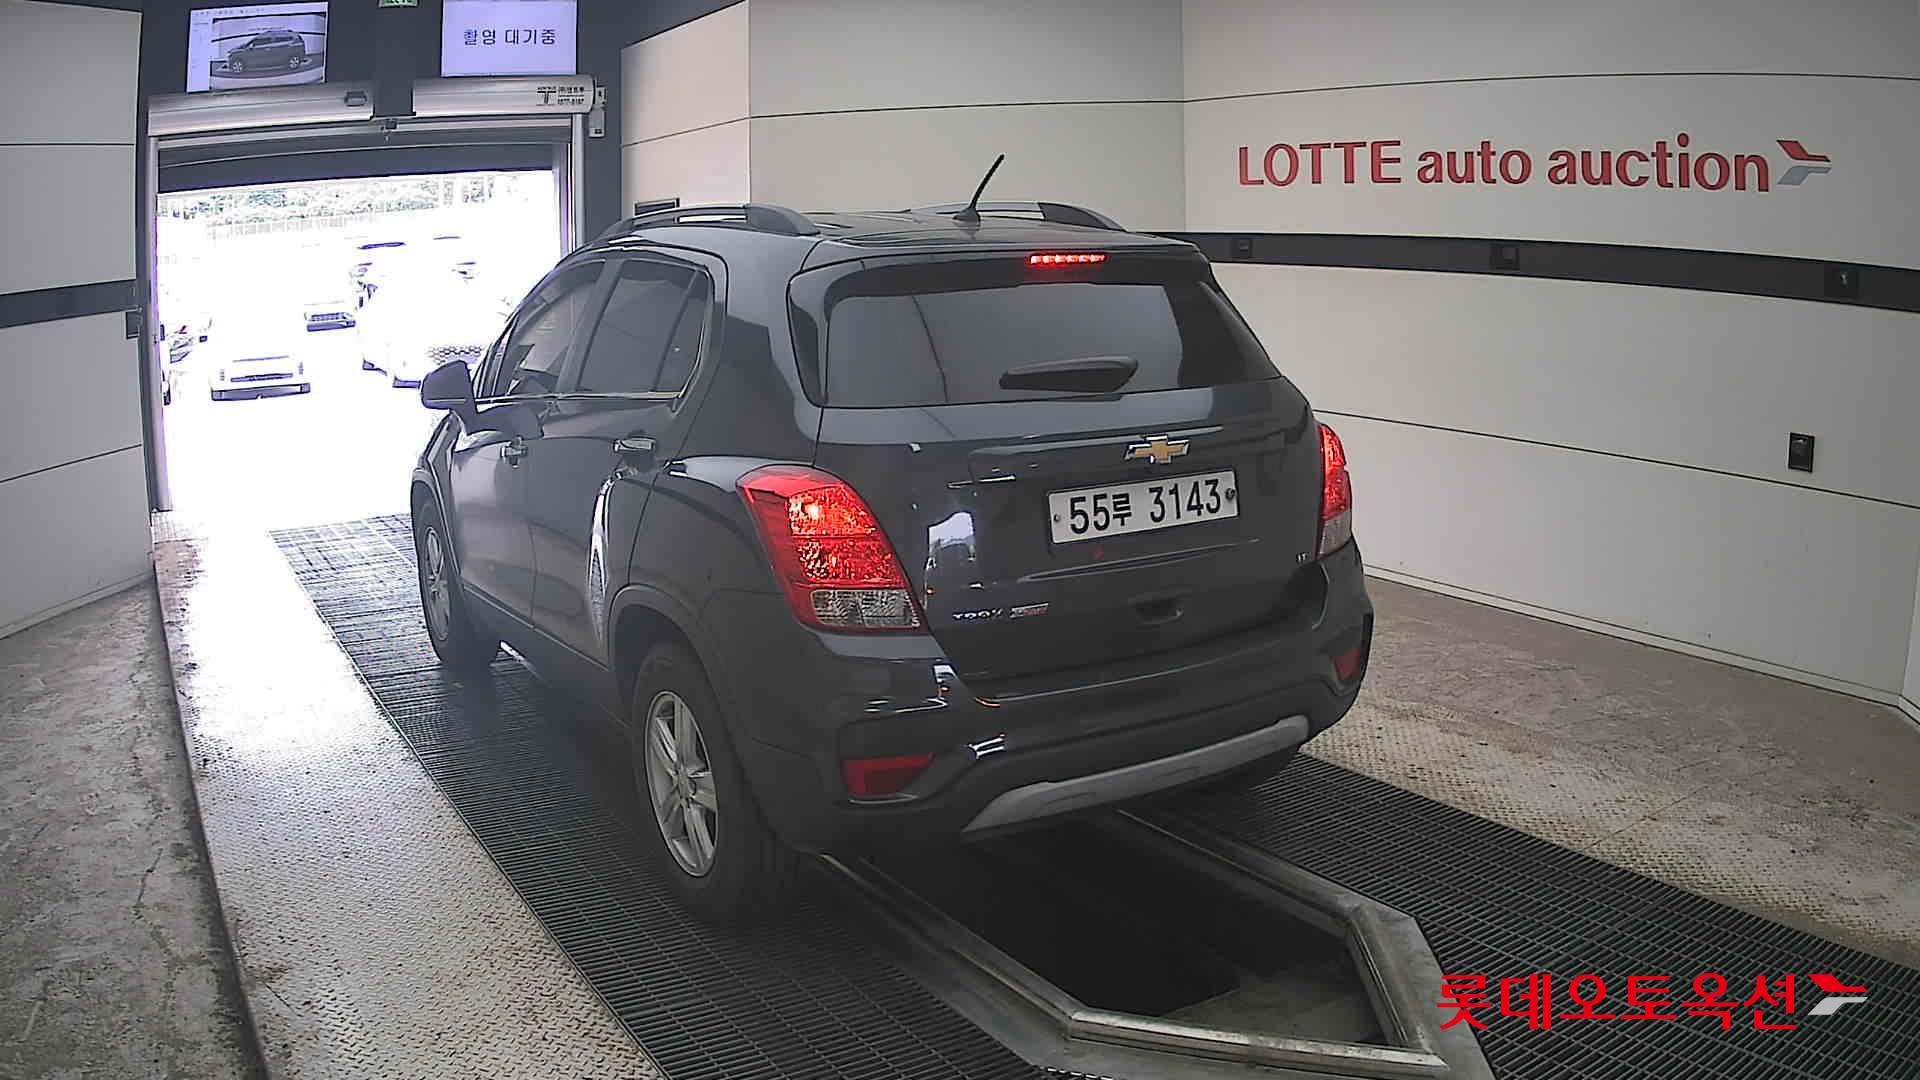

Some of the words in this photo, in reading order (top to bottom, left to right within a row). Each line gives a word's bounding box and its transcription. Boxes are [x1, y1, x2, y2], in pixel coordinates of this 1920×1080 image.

[504, 28, 556, 46] 대기중
[1238, 139, 1401, 187] LOTTE
[1417, 140, 1532, 185] auto
[1547, 133, 1770, 191] auction
[1070, 492, 1132, 535] 55루
[1149, 478, 1221, 523] 3143
